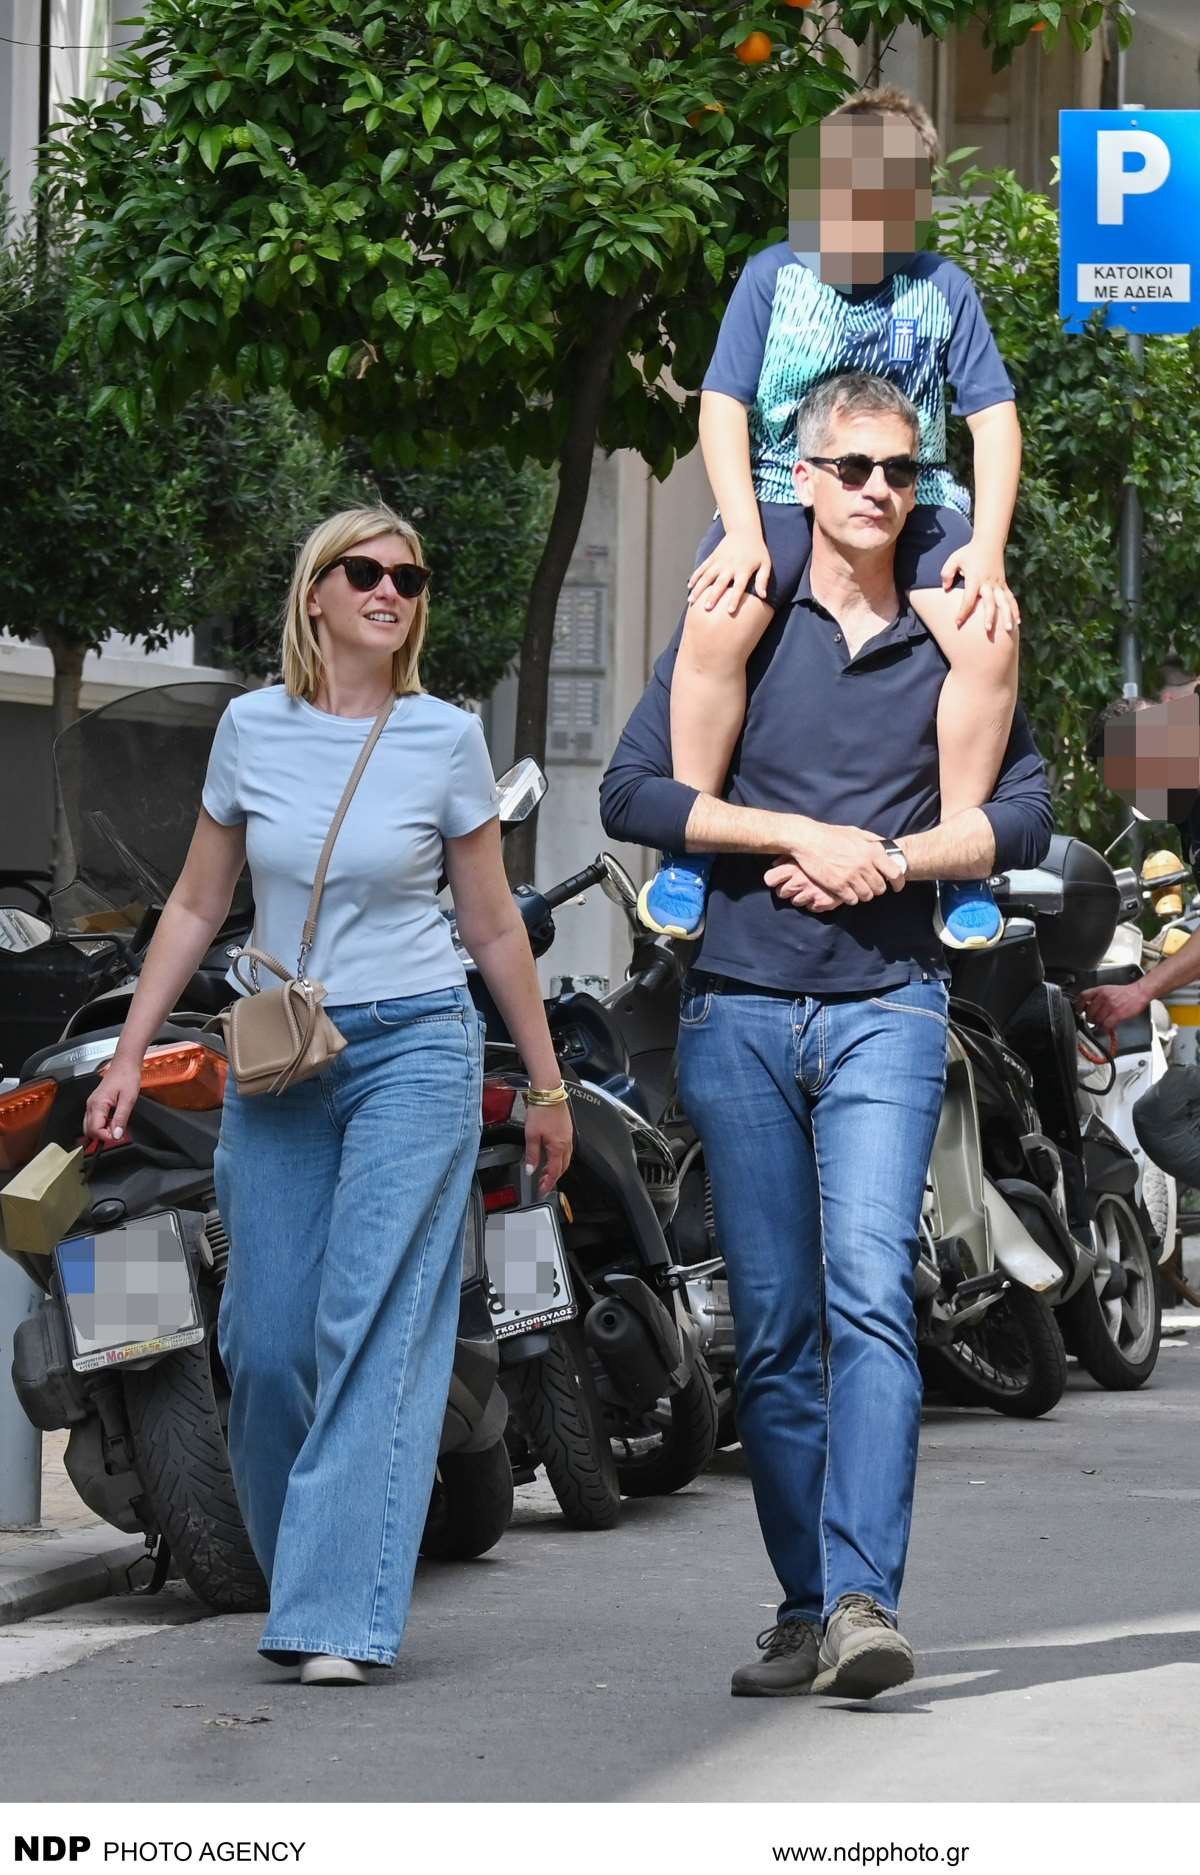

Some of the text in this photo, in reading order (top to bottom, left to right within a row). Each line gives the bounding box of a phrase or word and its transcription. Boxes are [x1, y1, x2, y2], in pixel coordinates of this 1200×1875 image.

[1097, 130, 1171, 225] P
[1094, 266, 1173, 280] ΚΑΤΟΙΚΟΙ
[1095, 286, 1173, 299] ΜΕ ΑΔΕΙΑ
[495, 1307, 573, 1336] ΓΚΟΤΣΟΠΟΥΛΟΣ
